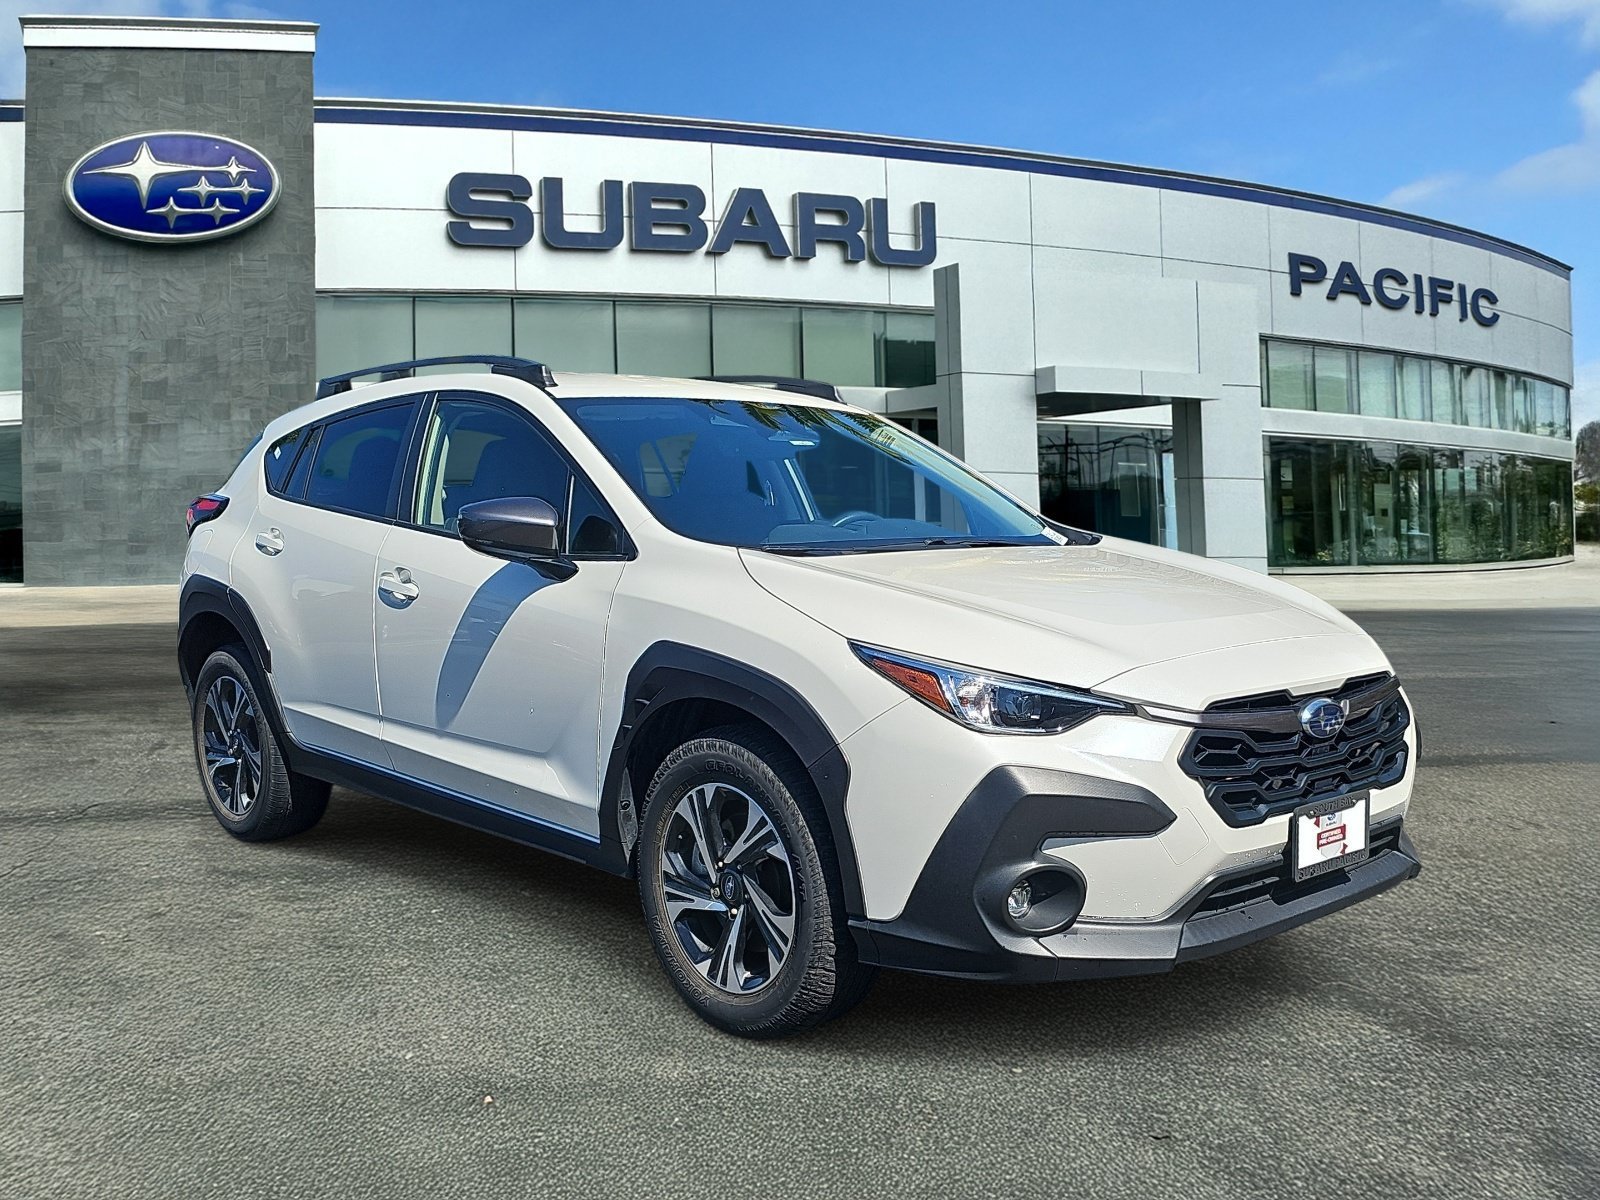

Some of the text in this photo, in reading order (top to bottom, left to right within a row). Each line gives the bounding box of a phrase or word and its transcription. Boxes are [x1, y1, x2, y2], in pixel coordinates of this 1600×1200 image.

[446, 171, 937, 267] SUBARU
[1287, 252, 1501, 327] PACIFIC
[1314, 796, 1354, 813] SOUTH BAY
[1297, 861, 1335, 880] SUBARU
[652, 914, 710, 1008] YOKOHAMA
